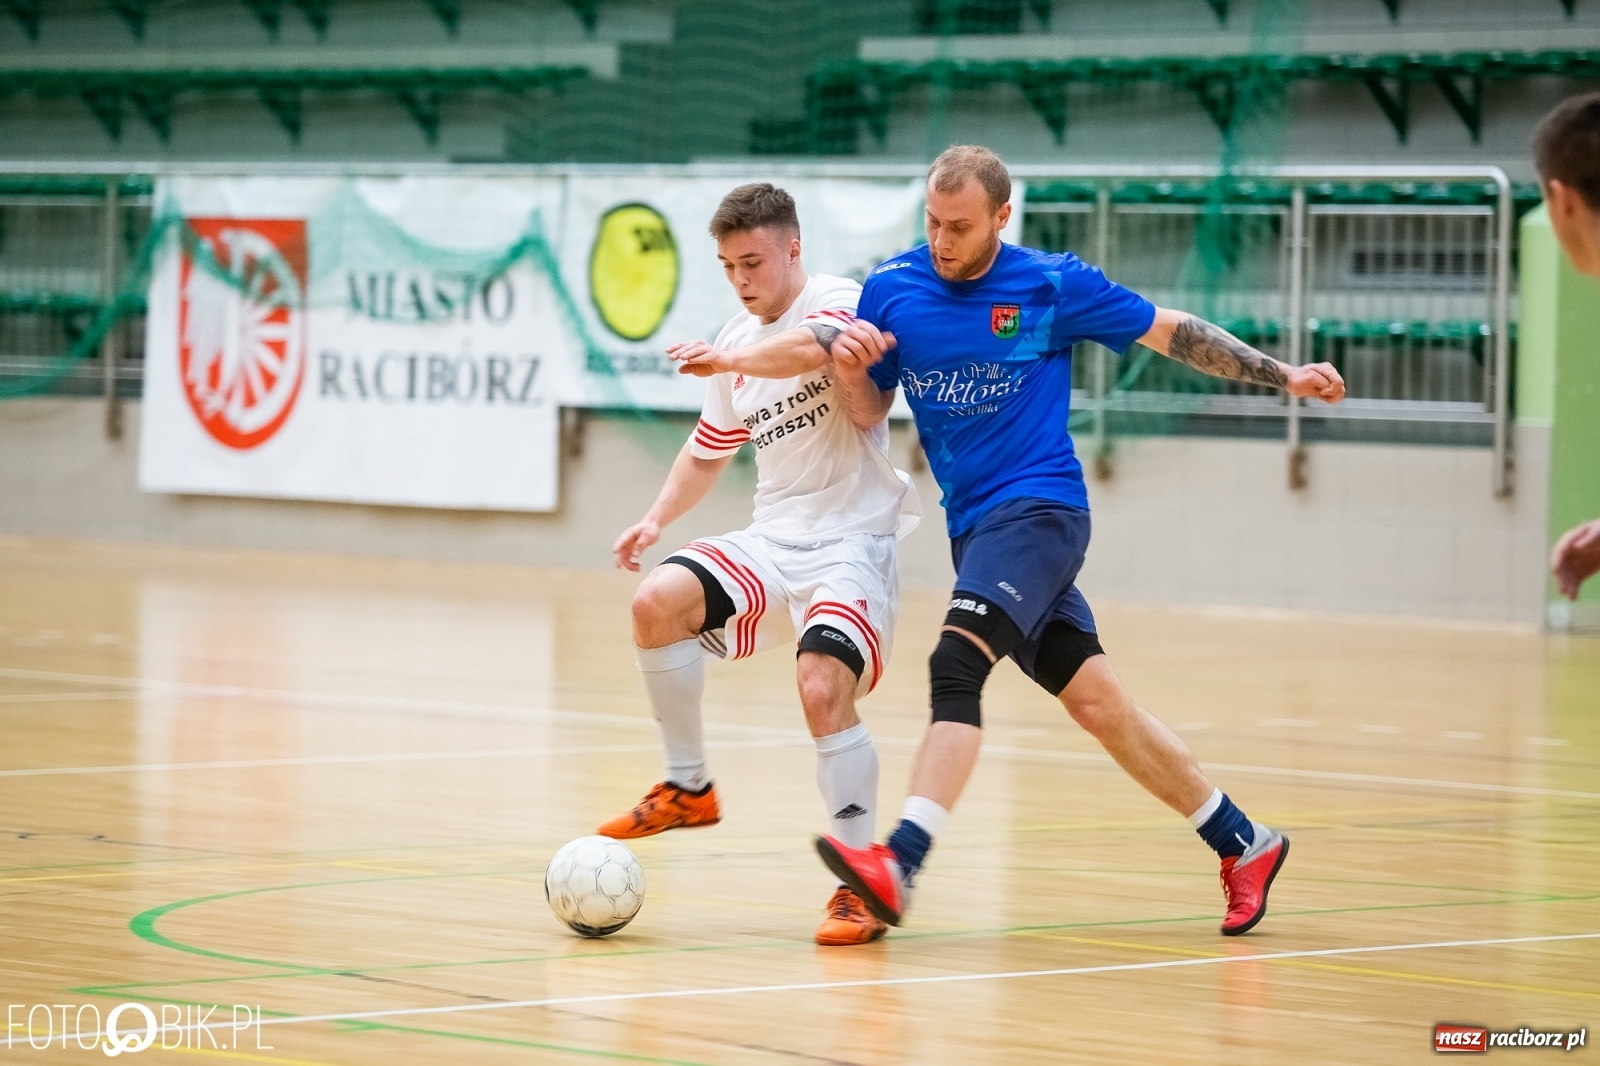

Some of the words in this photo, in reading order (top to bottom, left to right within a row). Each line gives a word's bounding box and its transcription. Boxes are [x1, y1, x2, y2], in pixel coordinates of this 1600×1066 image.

[774, 401, 785, 415] z
[787, 375, 832, 409] rolki
[751, 402, 830, 449] etraszyn
